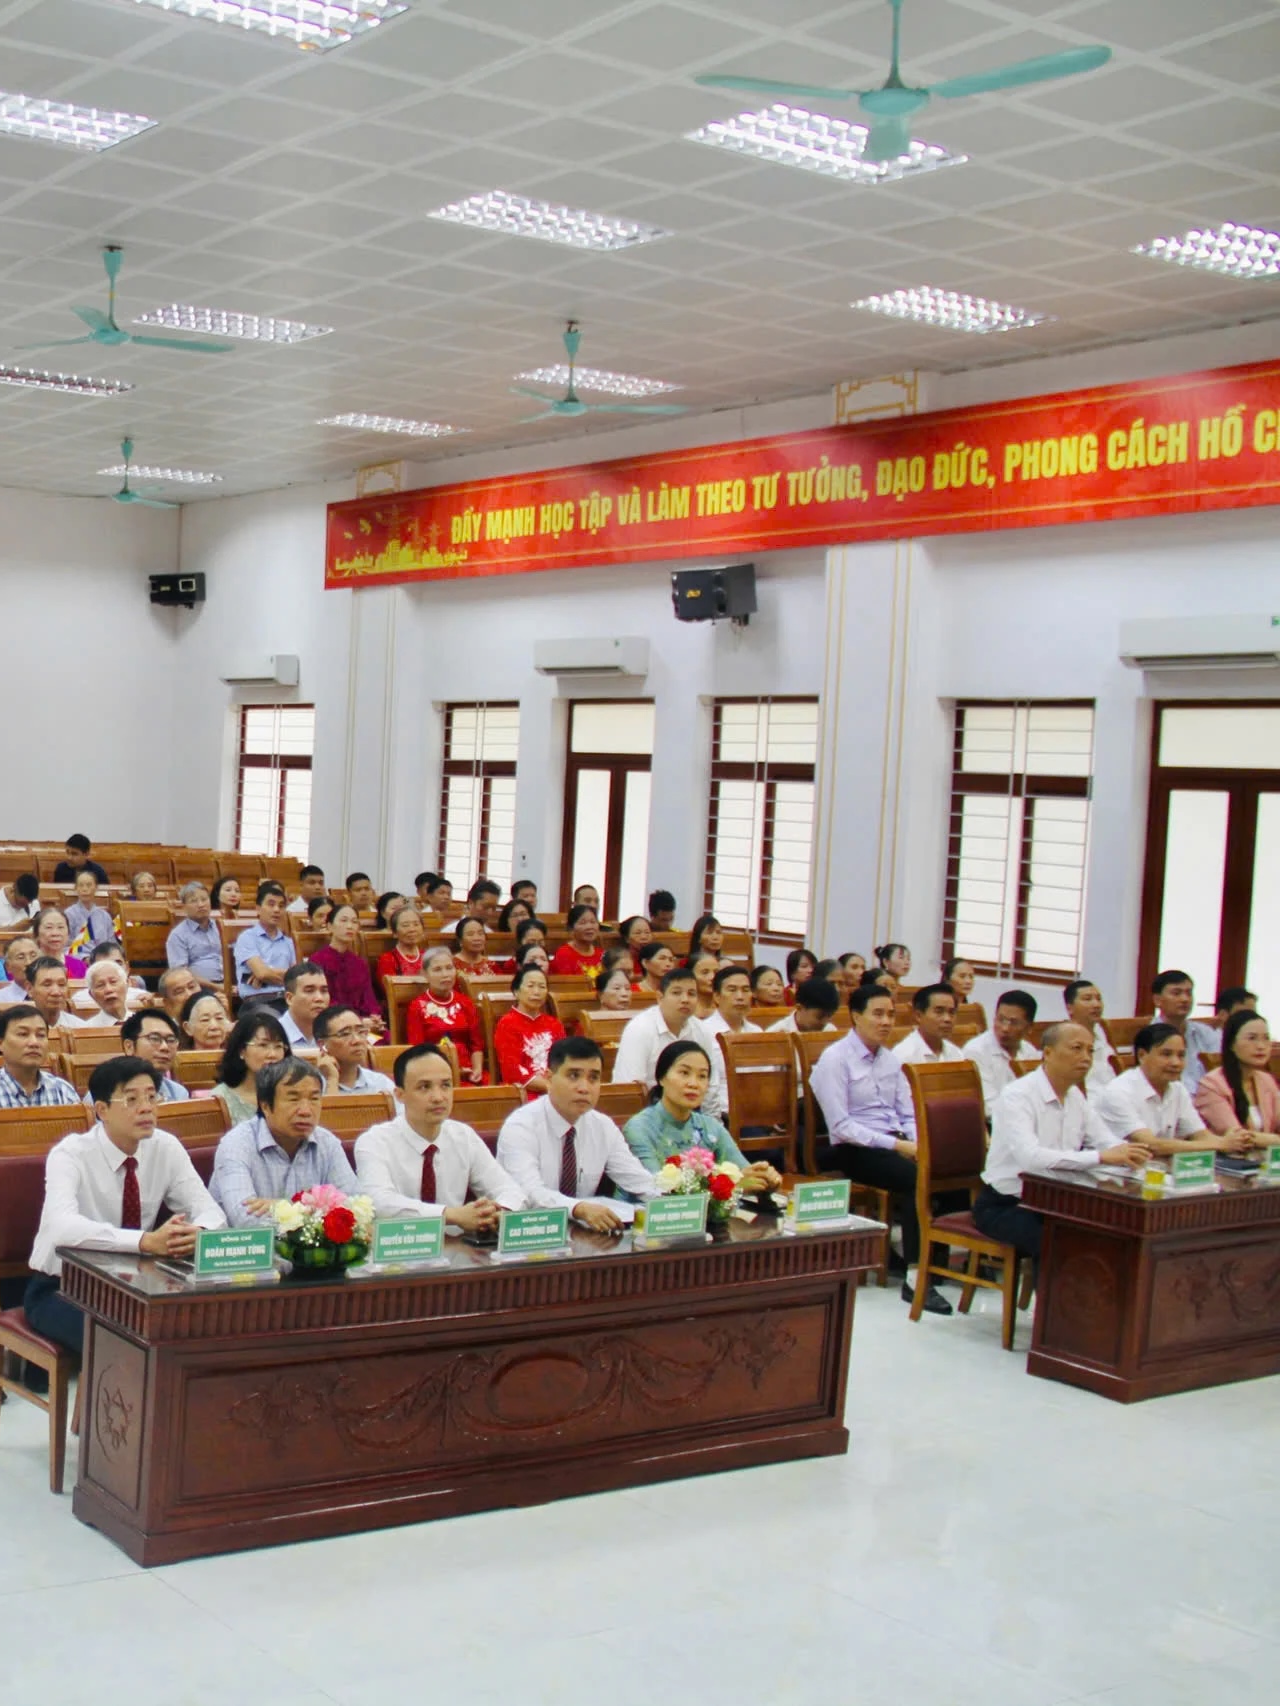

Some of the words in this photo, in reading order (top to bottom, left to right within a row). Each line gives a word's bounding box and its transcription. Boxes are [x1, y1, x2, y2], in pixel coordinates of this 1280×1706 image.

[451, 506, 482, 544] ĐẨY
[485, 506, 535, 544] MẠNH
[539, 501, 575, 539] HỌC
[578, 489, 614, 534] TẬP
[617, 486, 642, 526] VÀ
[646, 482, 690, 522] LÀM
[695, 478, 746, 516] THEO
[751, 472, 781, 510] TƯ
[786, 455, 869, 507] TƯỞNG,
[876, 456, 925, 501] ĐẠO
[933, 442, 995, 490] ĐỨC,
[1004, 433, 1098, 482] PHONG
[1107, 418, 1190, 470] CÁCH
[1198, 402, 1248, 460] HỒ
[1253, 408, 1280, 454] C
